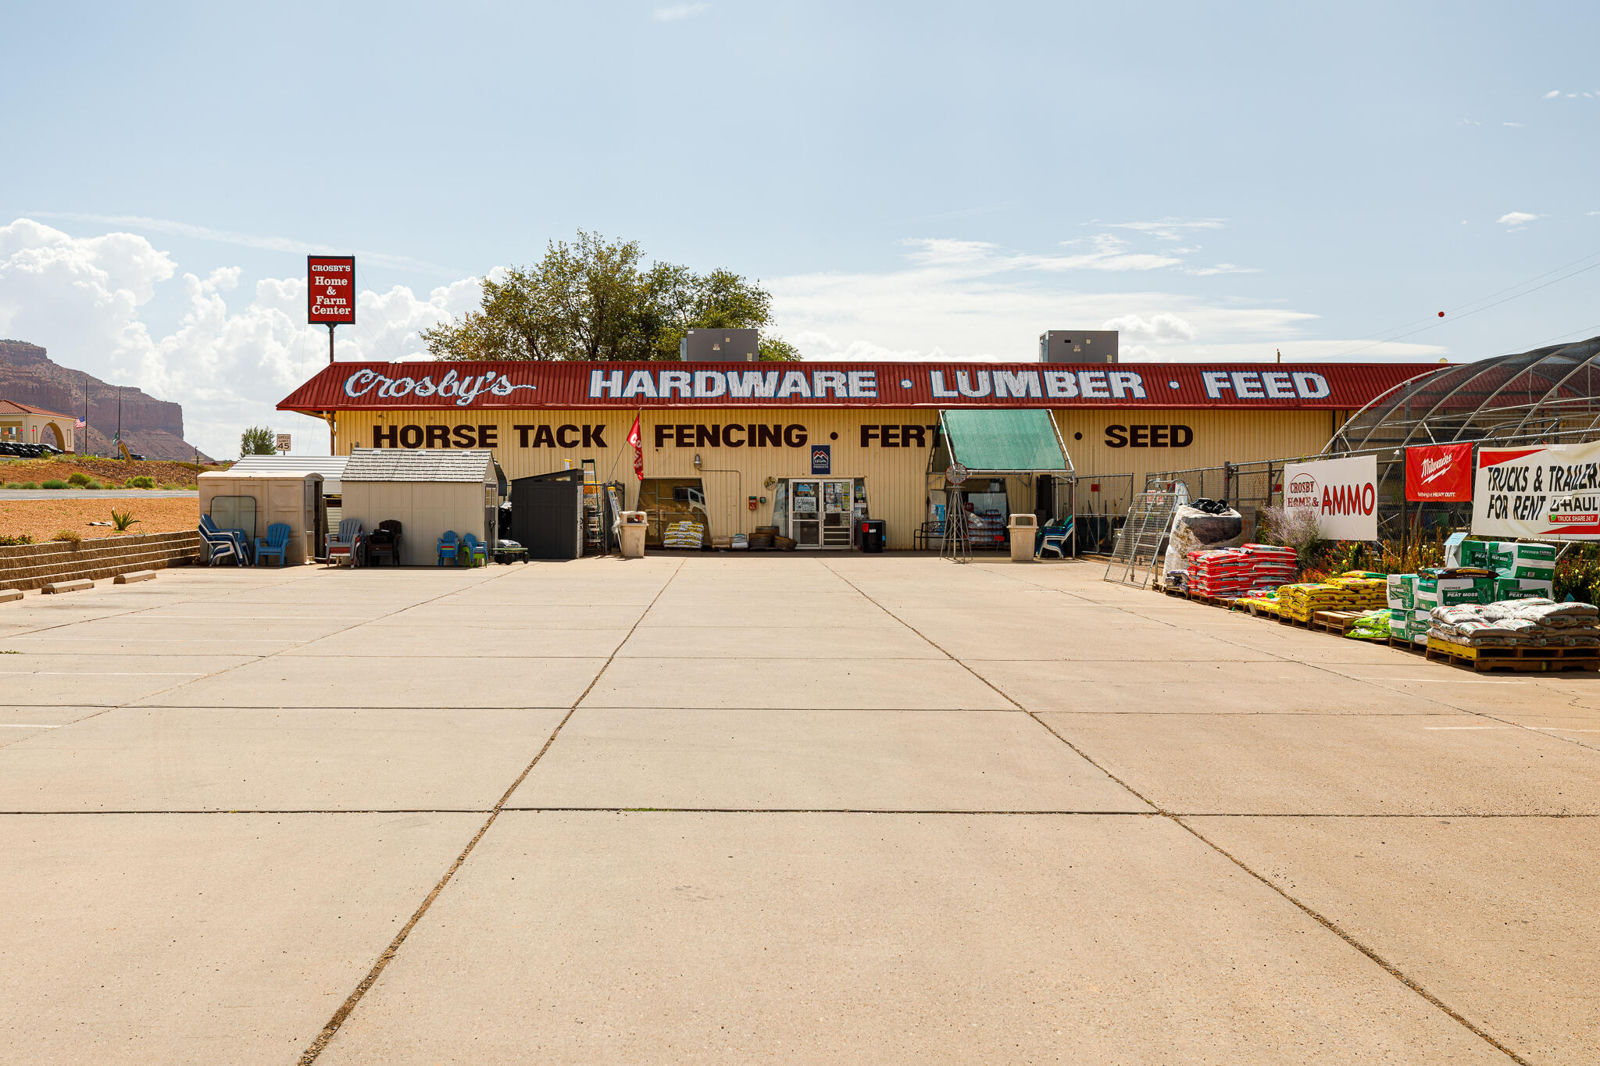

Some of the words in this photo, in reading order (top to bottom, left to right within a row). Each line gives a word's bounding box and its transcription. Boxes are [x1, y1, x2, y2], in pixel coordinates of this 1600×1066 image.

[314, 276, 348, 286] Home
[326, 286, 337, 296] &
[311, 305, 351, 315] Center
[316, 296, 347, 305] Farm
[344, 369, 537, 407] Crosby's
[588, 369, 878, 399] HARDWARE
[930, 369, 1147, 399] LUMBER
[1202, 370, 1331, 400] FEED
[373, 425, 498, 448] HORSE
[513, 425, 608, 448] TACK
[655, 424, 808, 448] FENCING
[1104, 424, 1194, 448] SEED
[1420, 453, 1453, 479] Milwaukee
[1290, 481, 1315, 494] CROSBY
[1487, 466, 1530, 492] TRUCKS
[1533, 466, 1543, 492] &
[1287, 497, 1311, 507] HOME
[1312, 497, 1319, 507] &
[1321, 482, 1375, 516] AMMO
[1486, 494, 1508, 519] FOR
[1513, 496, 1546, 520] RENT
